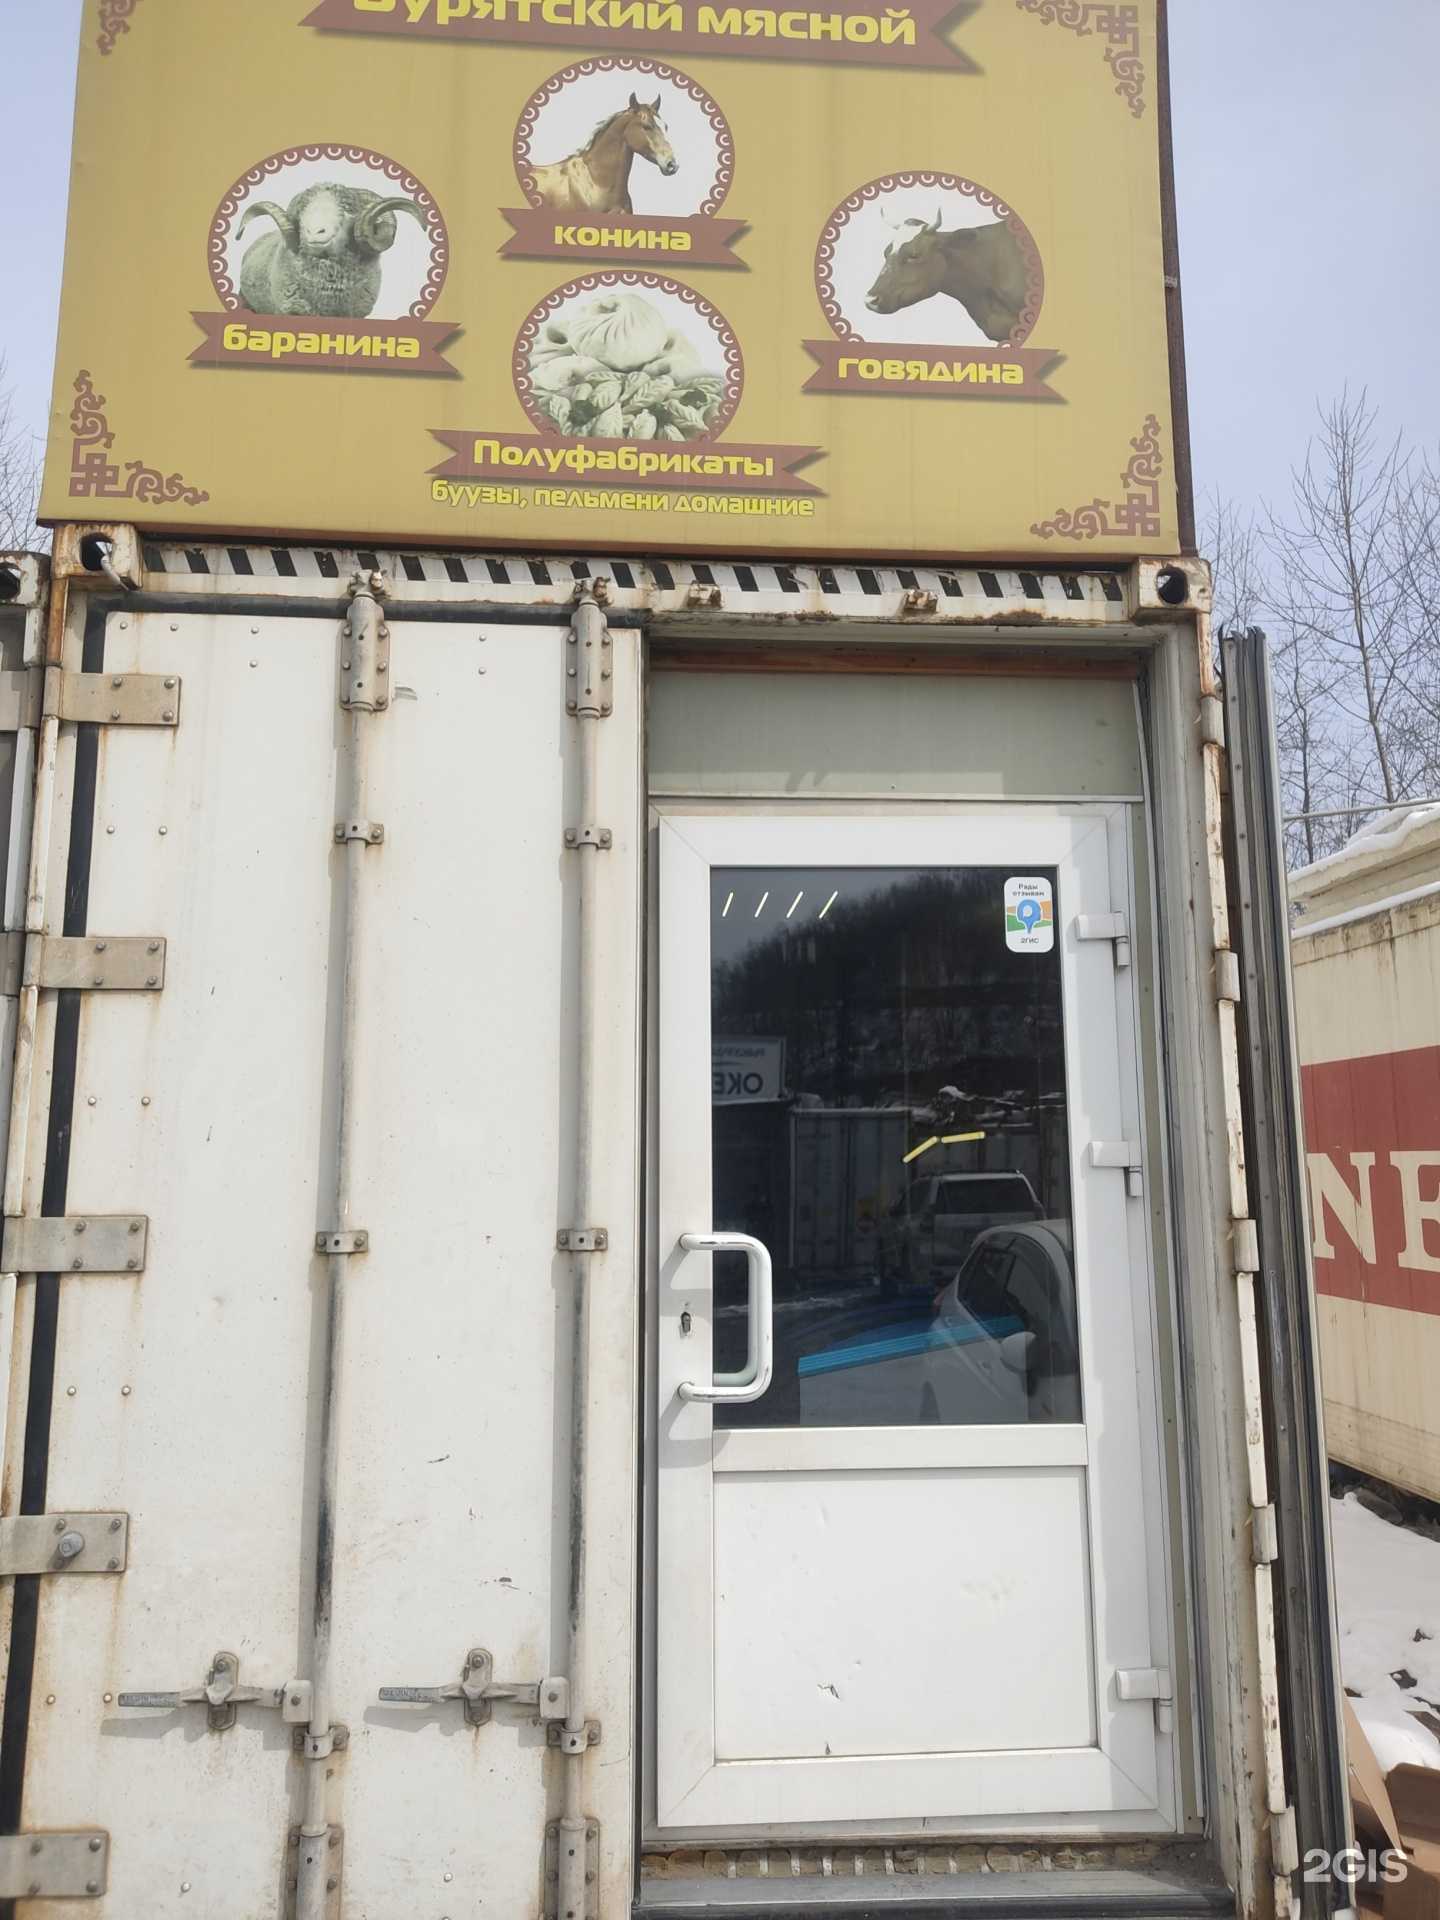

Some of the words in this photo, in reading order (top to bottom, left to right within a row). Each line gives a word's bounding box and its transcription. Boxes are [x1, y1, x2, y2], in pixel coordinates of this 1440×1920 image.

[352, 0, 684, 32] урятский
[697, 8, 918, 46] мясной
[553, 224, 692, 252] конина
[221, 323, 421, 359] баранина
[838, 358, 1024, 385] говядина
[473, 438, 775, 477] Полуфабрикаты
[431, 480, 528, 509] буузы,
[534, 488, 669, 512] пельмени
[673, 494, 815, 517] домашние
